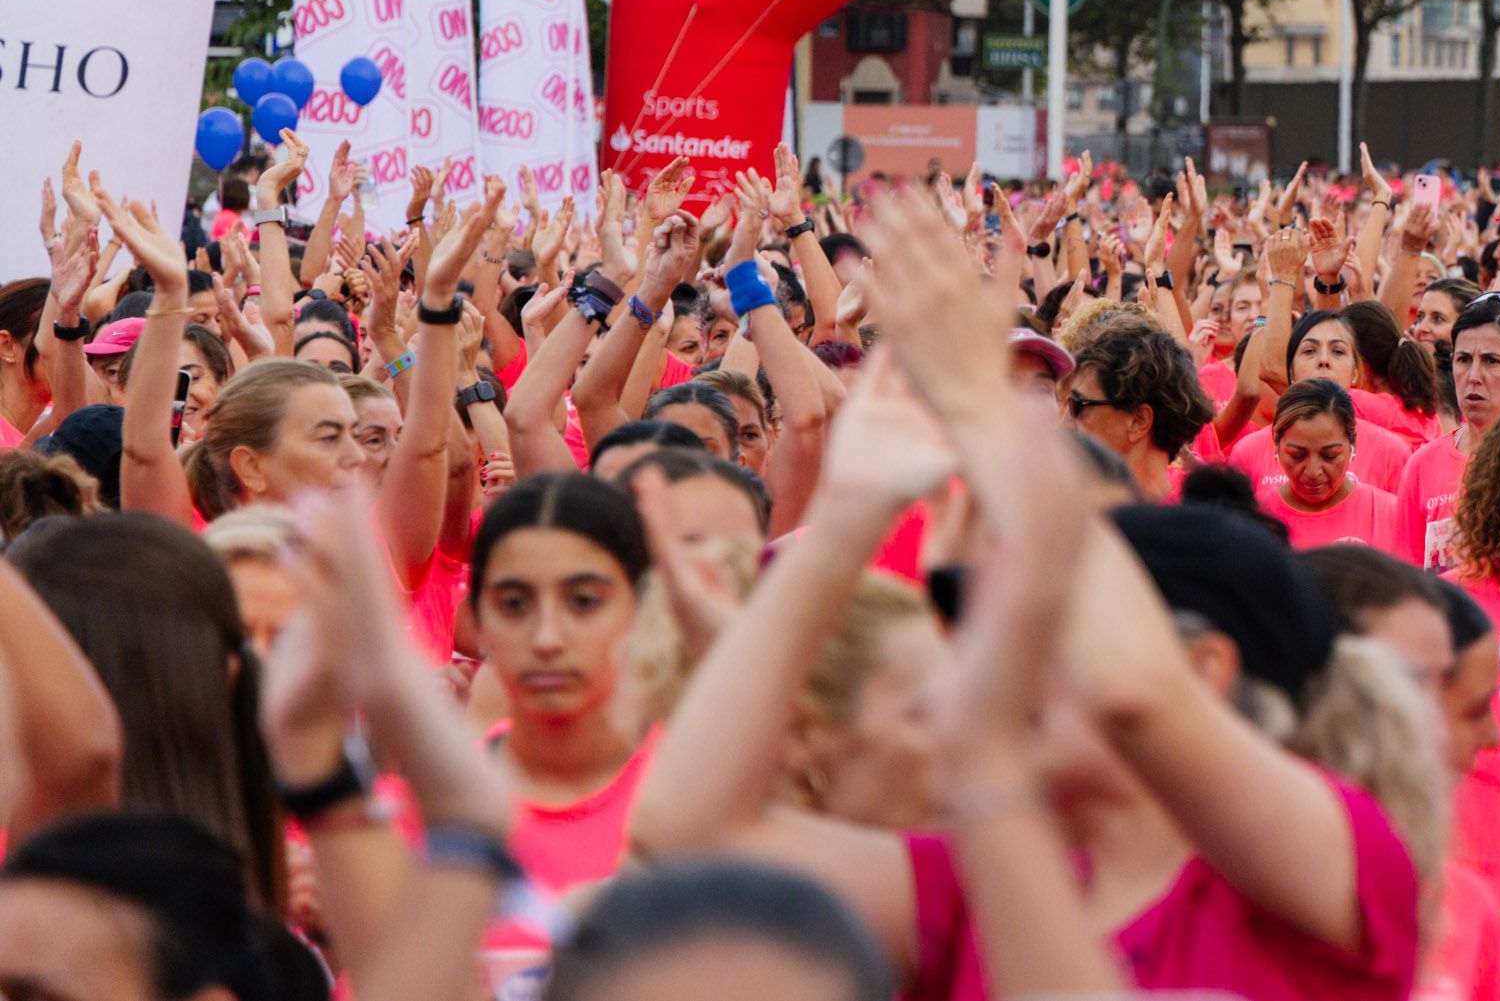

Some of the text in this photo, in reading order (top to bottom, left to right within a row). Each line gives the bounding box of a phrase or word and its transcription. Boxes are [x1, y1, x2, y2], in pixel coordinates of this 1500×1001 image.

[0, 38, 129, 99] HO
[643, 89, 720, 120] Sports
[632, 128, 752, 160] Santander
[1262, 475, 1289, 486] OYSH
